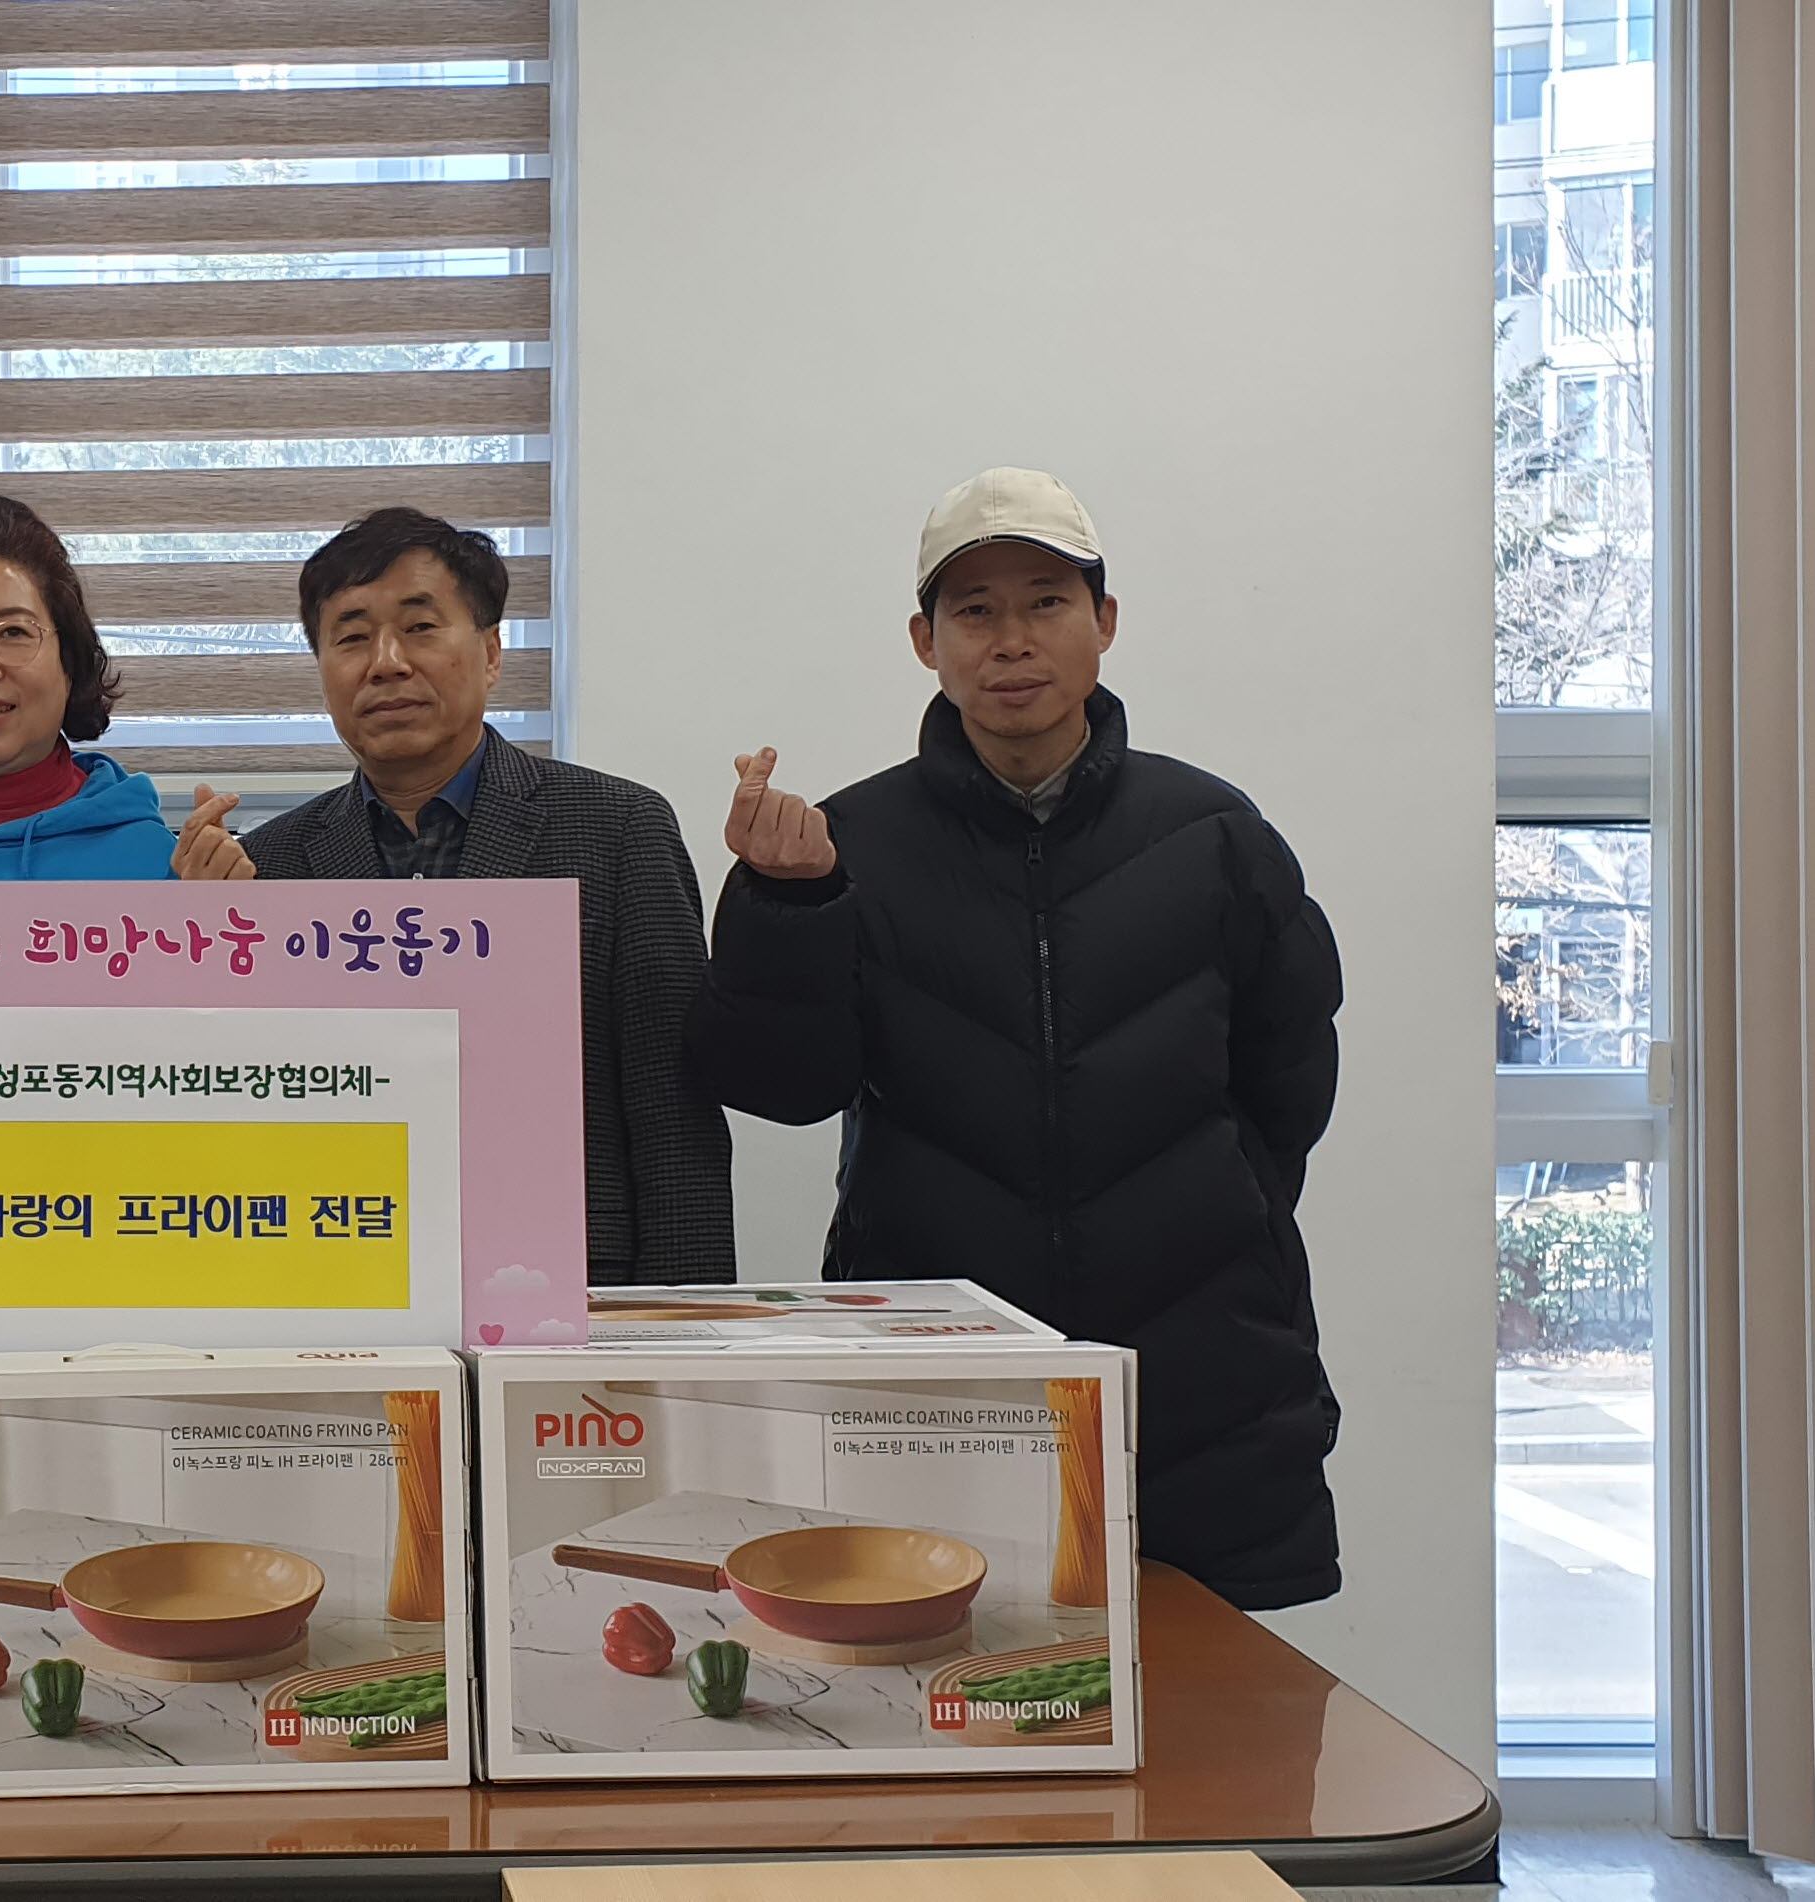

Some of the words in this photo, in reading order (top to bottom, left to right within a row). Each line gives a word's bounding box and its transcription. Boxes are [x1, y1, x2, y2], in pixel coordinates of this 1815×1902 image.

[25, 907, 266, 977] 희망나눔
[285, 907, 490, 978] 이웃돕기
[117, 1194, 288, 1238] 프라이팬
[310, 1194, 396, 1238] 전달
[831, 1411, 903, 1425] CERAMIC
[906, 1410, 974, 1425] COATING
[978, 1410, 1034, 1424] FRYING
[1038, 1410, 1070, 1423] PAN
[171, 1425, 242, 1440] CERAMIC
[245, 1424, 313, 1439] COATING
[317, 1423, 373, 1438] FRYING
[377, 1423, 409, 1436] PAN
[833, 1440, 903, 1456] 이녹스프랑
[908, 1440, 935, 1454] 피노
[940, 1441, 954, 1454] IH
[959, 1439, 1014, 1455] 프라이팬
[1031, 1440, 1070, 1453] 28cm
[173, 1455, 243, 1471] 이녹스프랑
[246, 1454, 274, 1469] 피노
[279, 1455, 293, 1468] IH
[297, 1453, 354, 1469] 프라이팬
[369, 1453, 408, 1467] 28cm
[541, 1462, 640, 1474] INOXPRAN
[934, 1703, 961, 1721] IH
[969, 1700, 1080, 1720] INDUCTION
[269, 1718, 297, 1737] IH
[305, 1715, 415, 1736] INDUCTION
